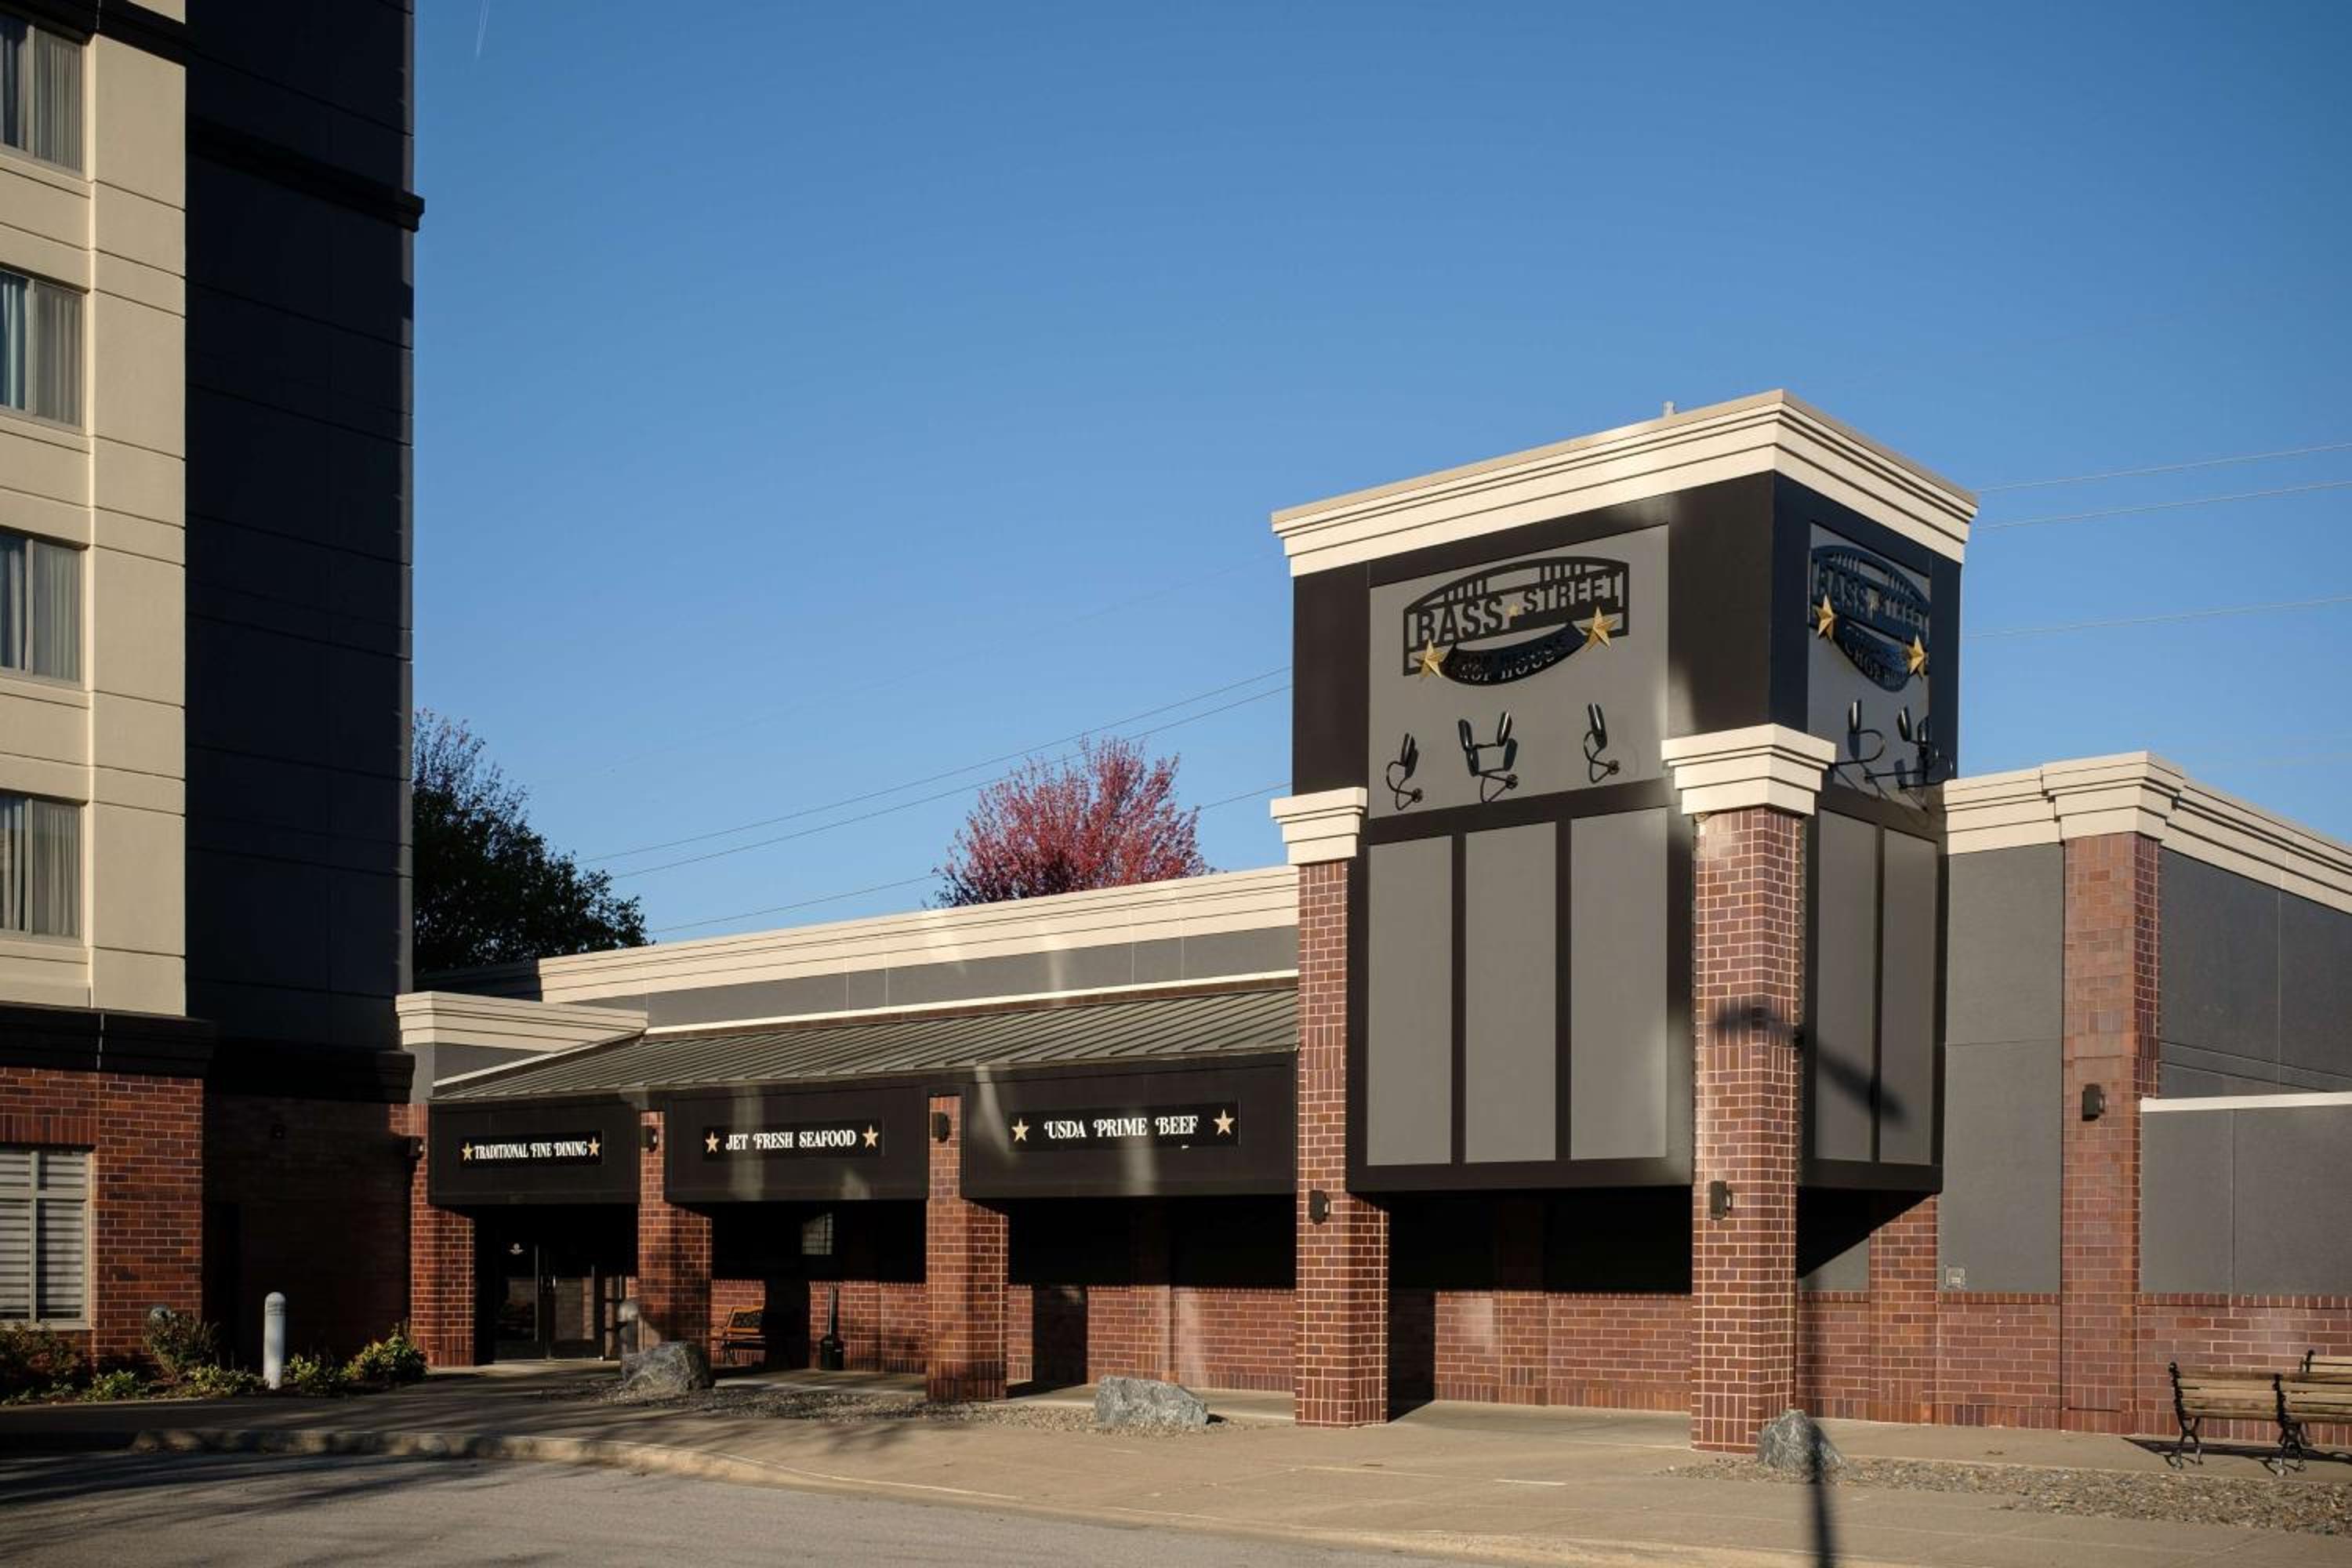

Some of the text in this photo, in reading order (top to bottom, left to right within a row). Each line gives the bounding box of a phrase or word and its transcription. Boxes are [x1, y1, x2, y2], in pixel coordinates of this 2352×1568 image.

[1417, 575, 1619, 646] BASS STREET
[1044, 1115, 1199, 1139] USDA PRIME BEEF
[475, 1142, 587, 1160] TRADITIONAL FINE DINING
[725, 1130, 856, 1150] JET FRESH SEAFOOD
